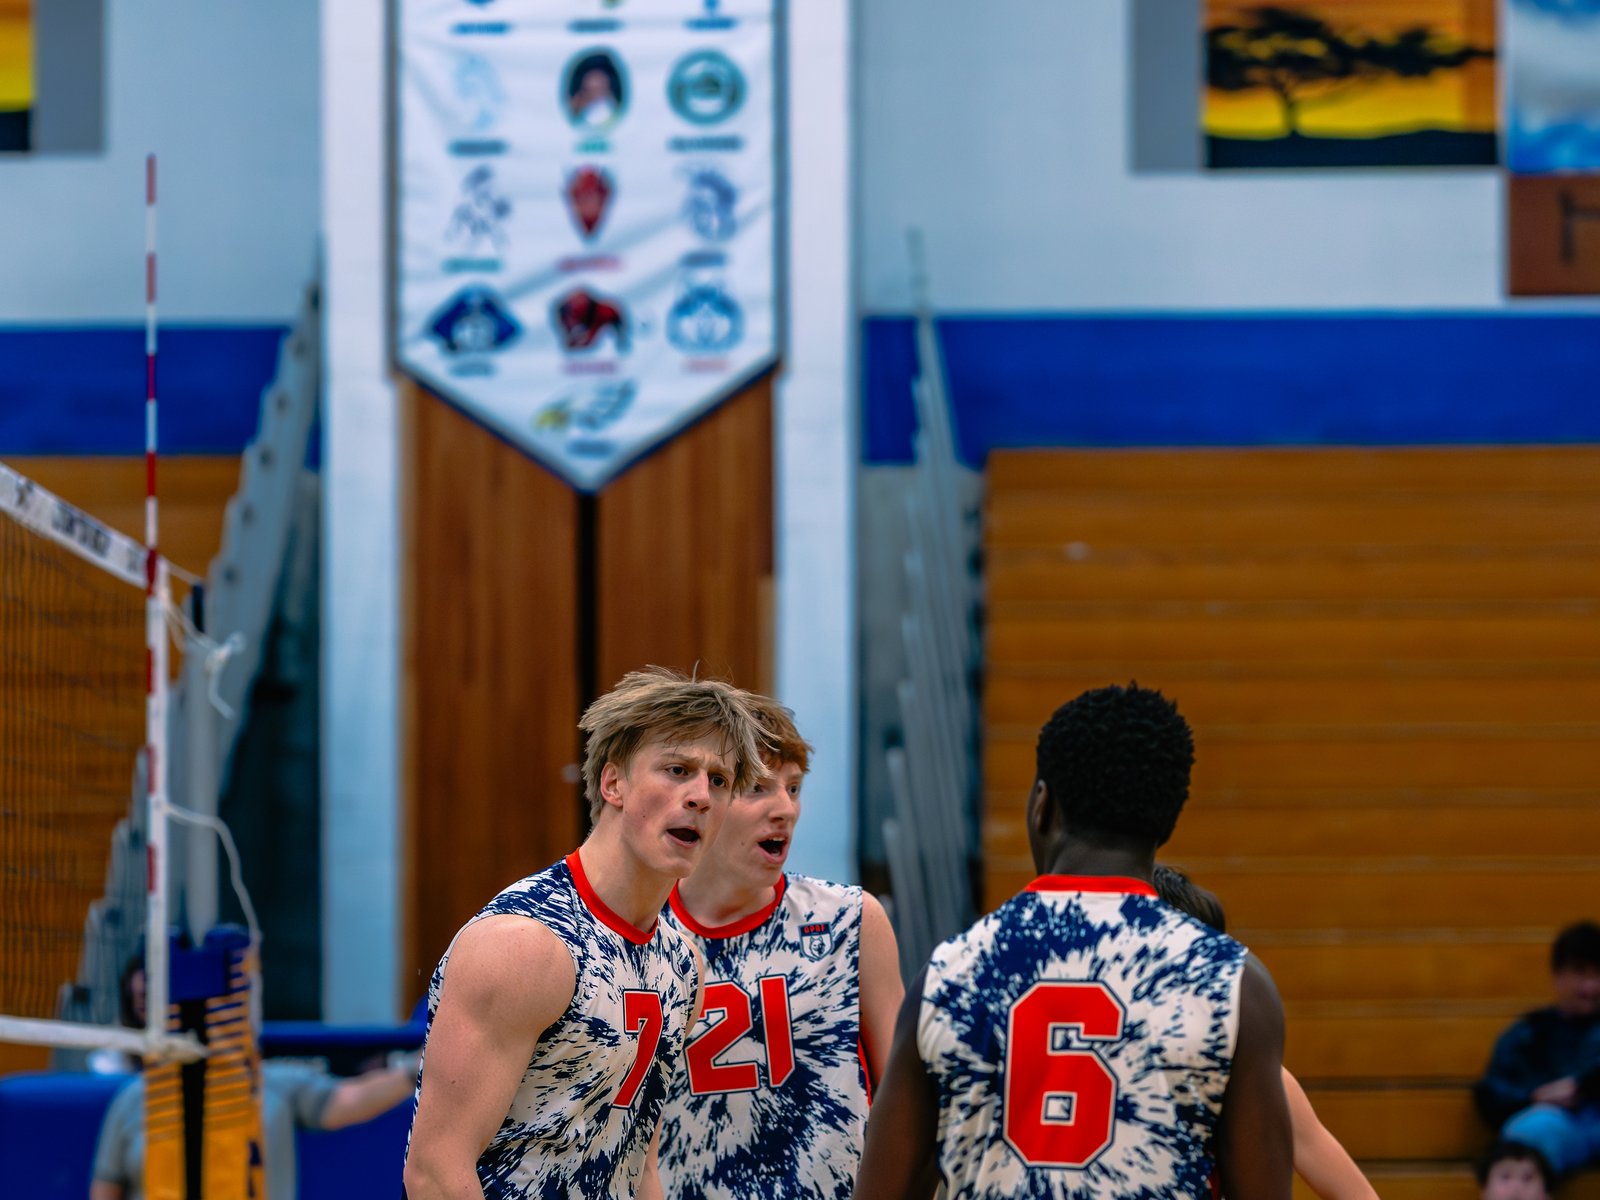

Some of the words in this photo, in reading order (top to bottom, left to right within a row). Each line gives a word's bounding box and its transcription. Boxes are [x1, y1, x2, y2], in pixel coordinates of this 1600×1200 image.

[612, 989, 663, 1109] 7
[683, 974, 796, 1097] 21
[1003, 978, 1127, 1171] 6
